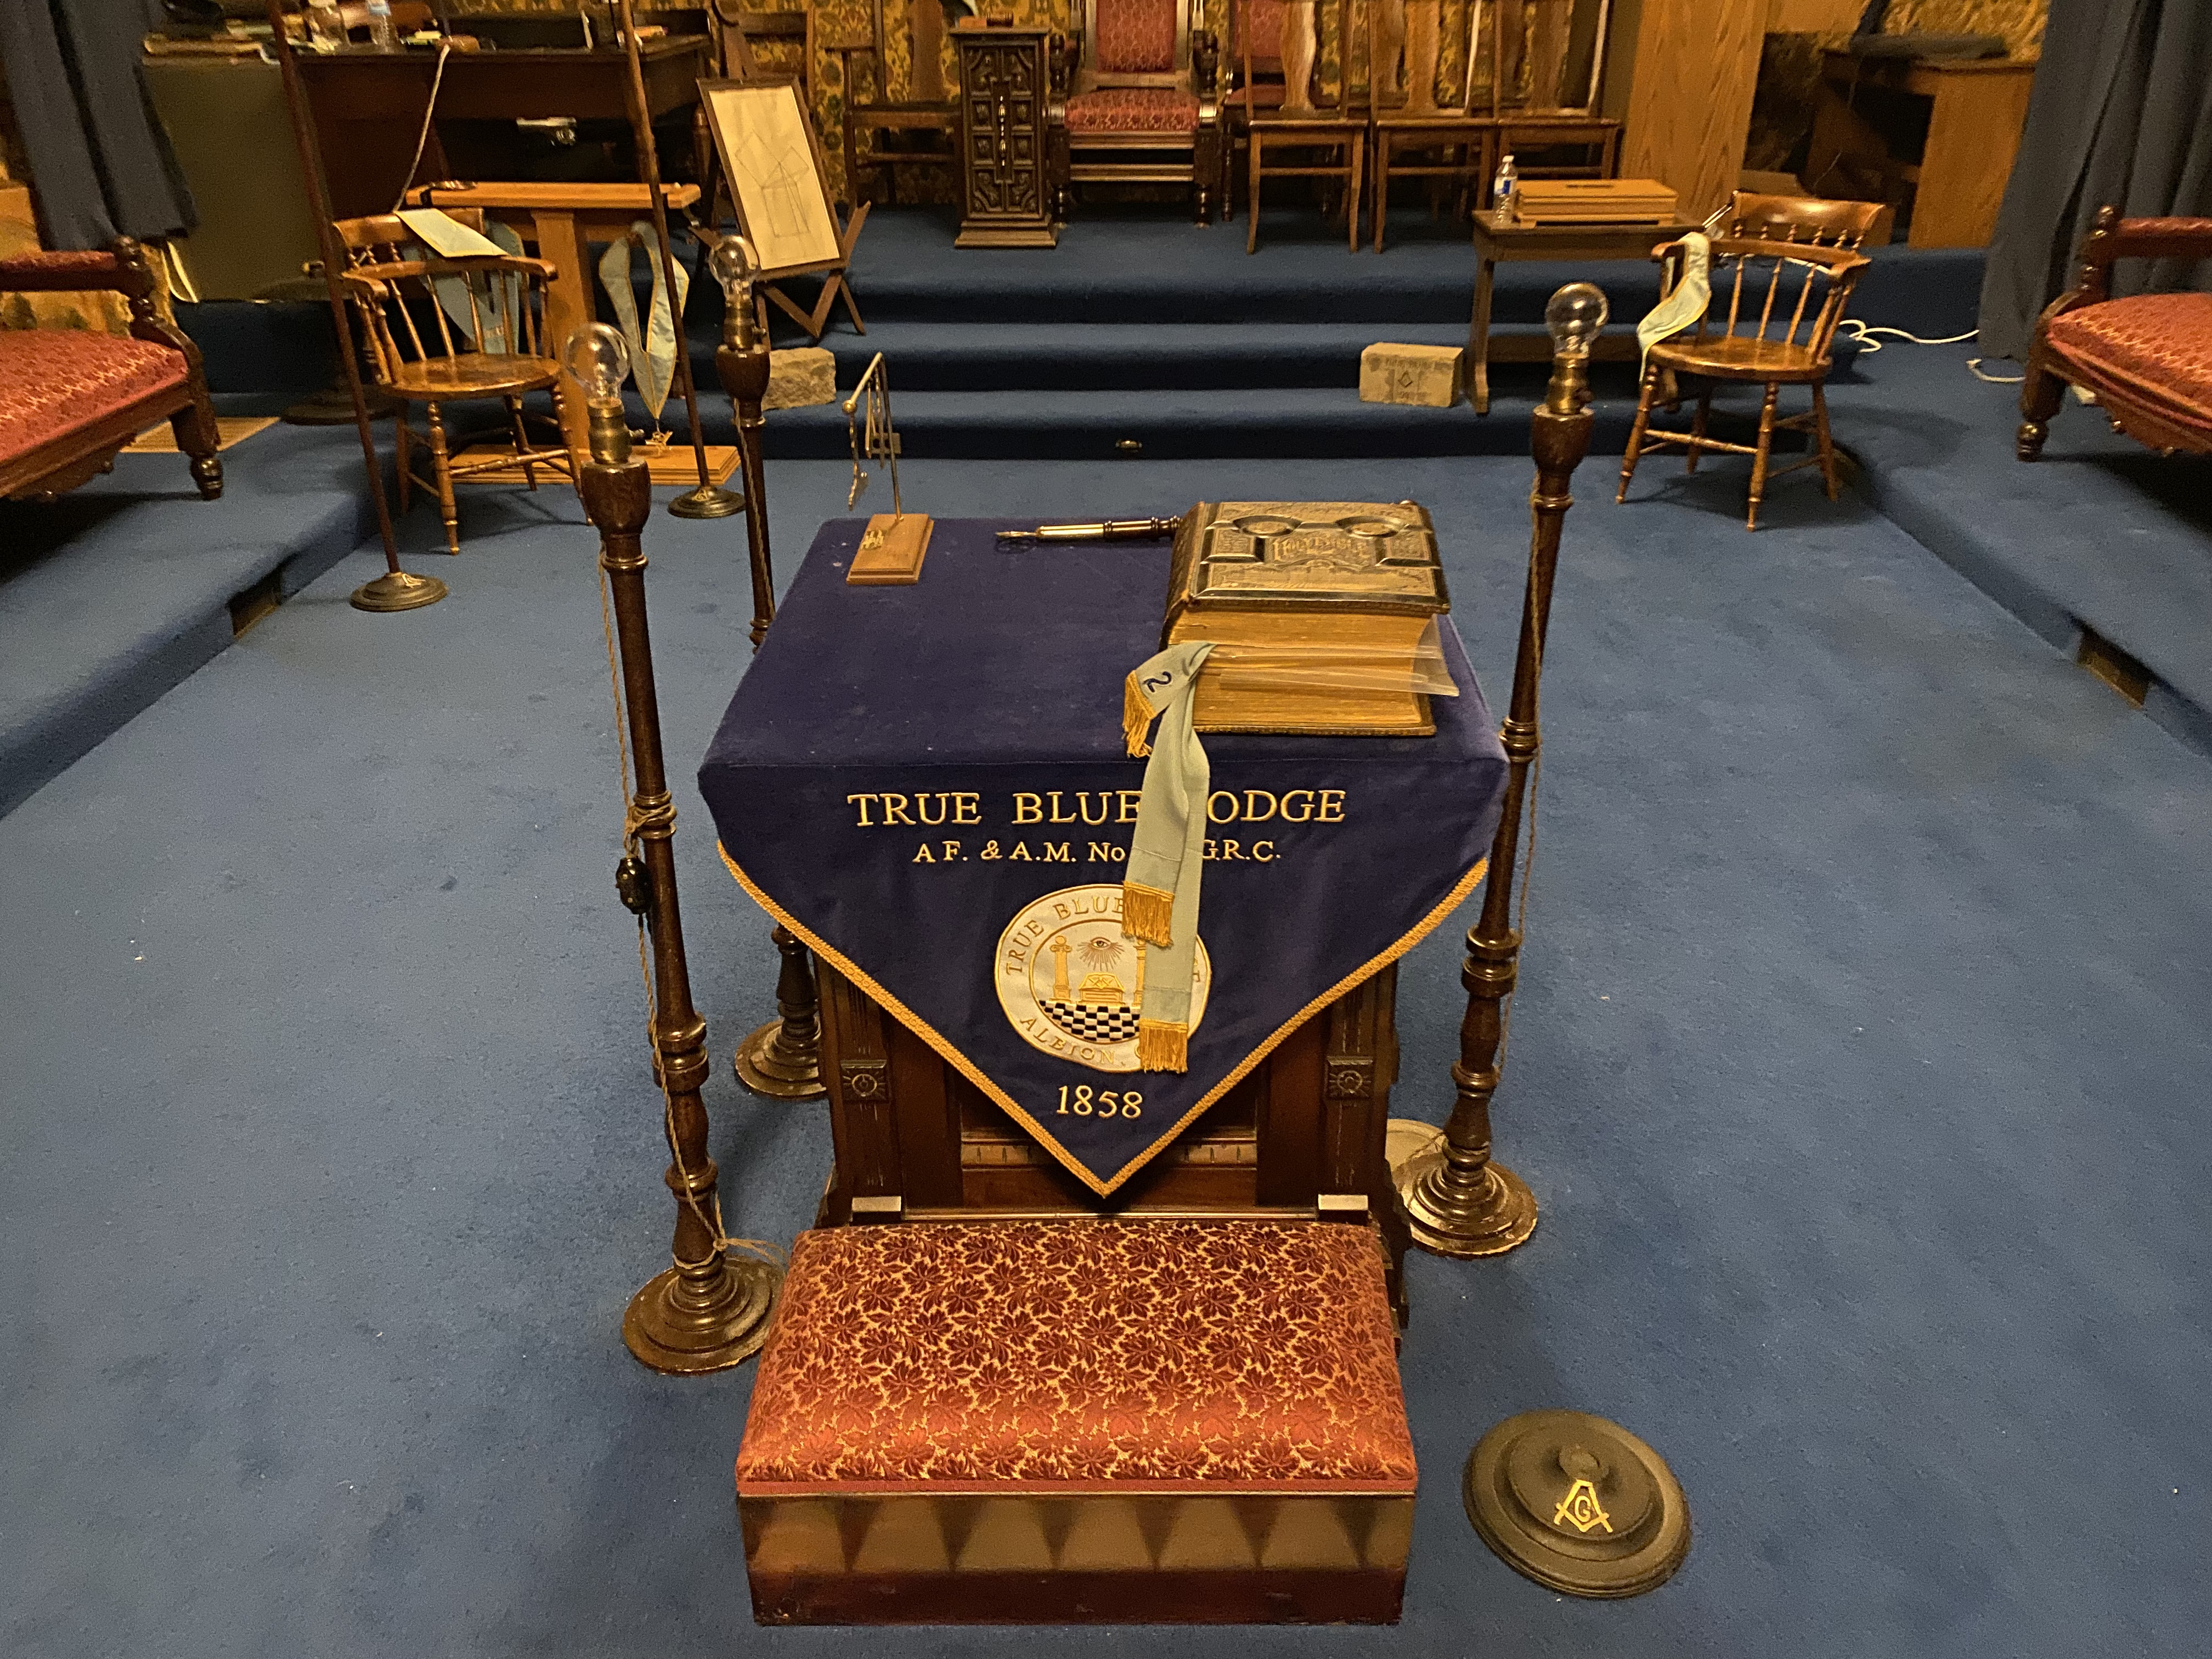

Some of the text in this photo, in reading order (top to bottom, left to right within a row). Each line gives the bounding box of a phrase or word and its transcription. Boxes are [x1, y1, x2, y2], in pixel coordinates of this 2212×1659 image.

[847, 789, 1346, 827] TRUE BLUE ODGE
[980, 840, 1003, 860] &
[1006, 896, 1124, 976] TRUE BLUE
[1056, 1085, 1143, 1118] 1858
[1575, 1496, 1592, 1522] G
